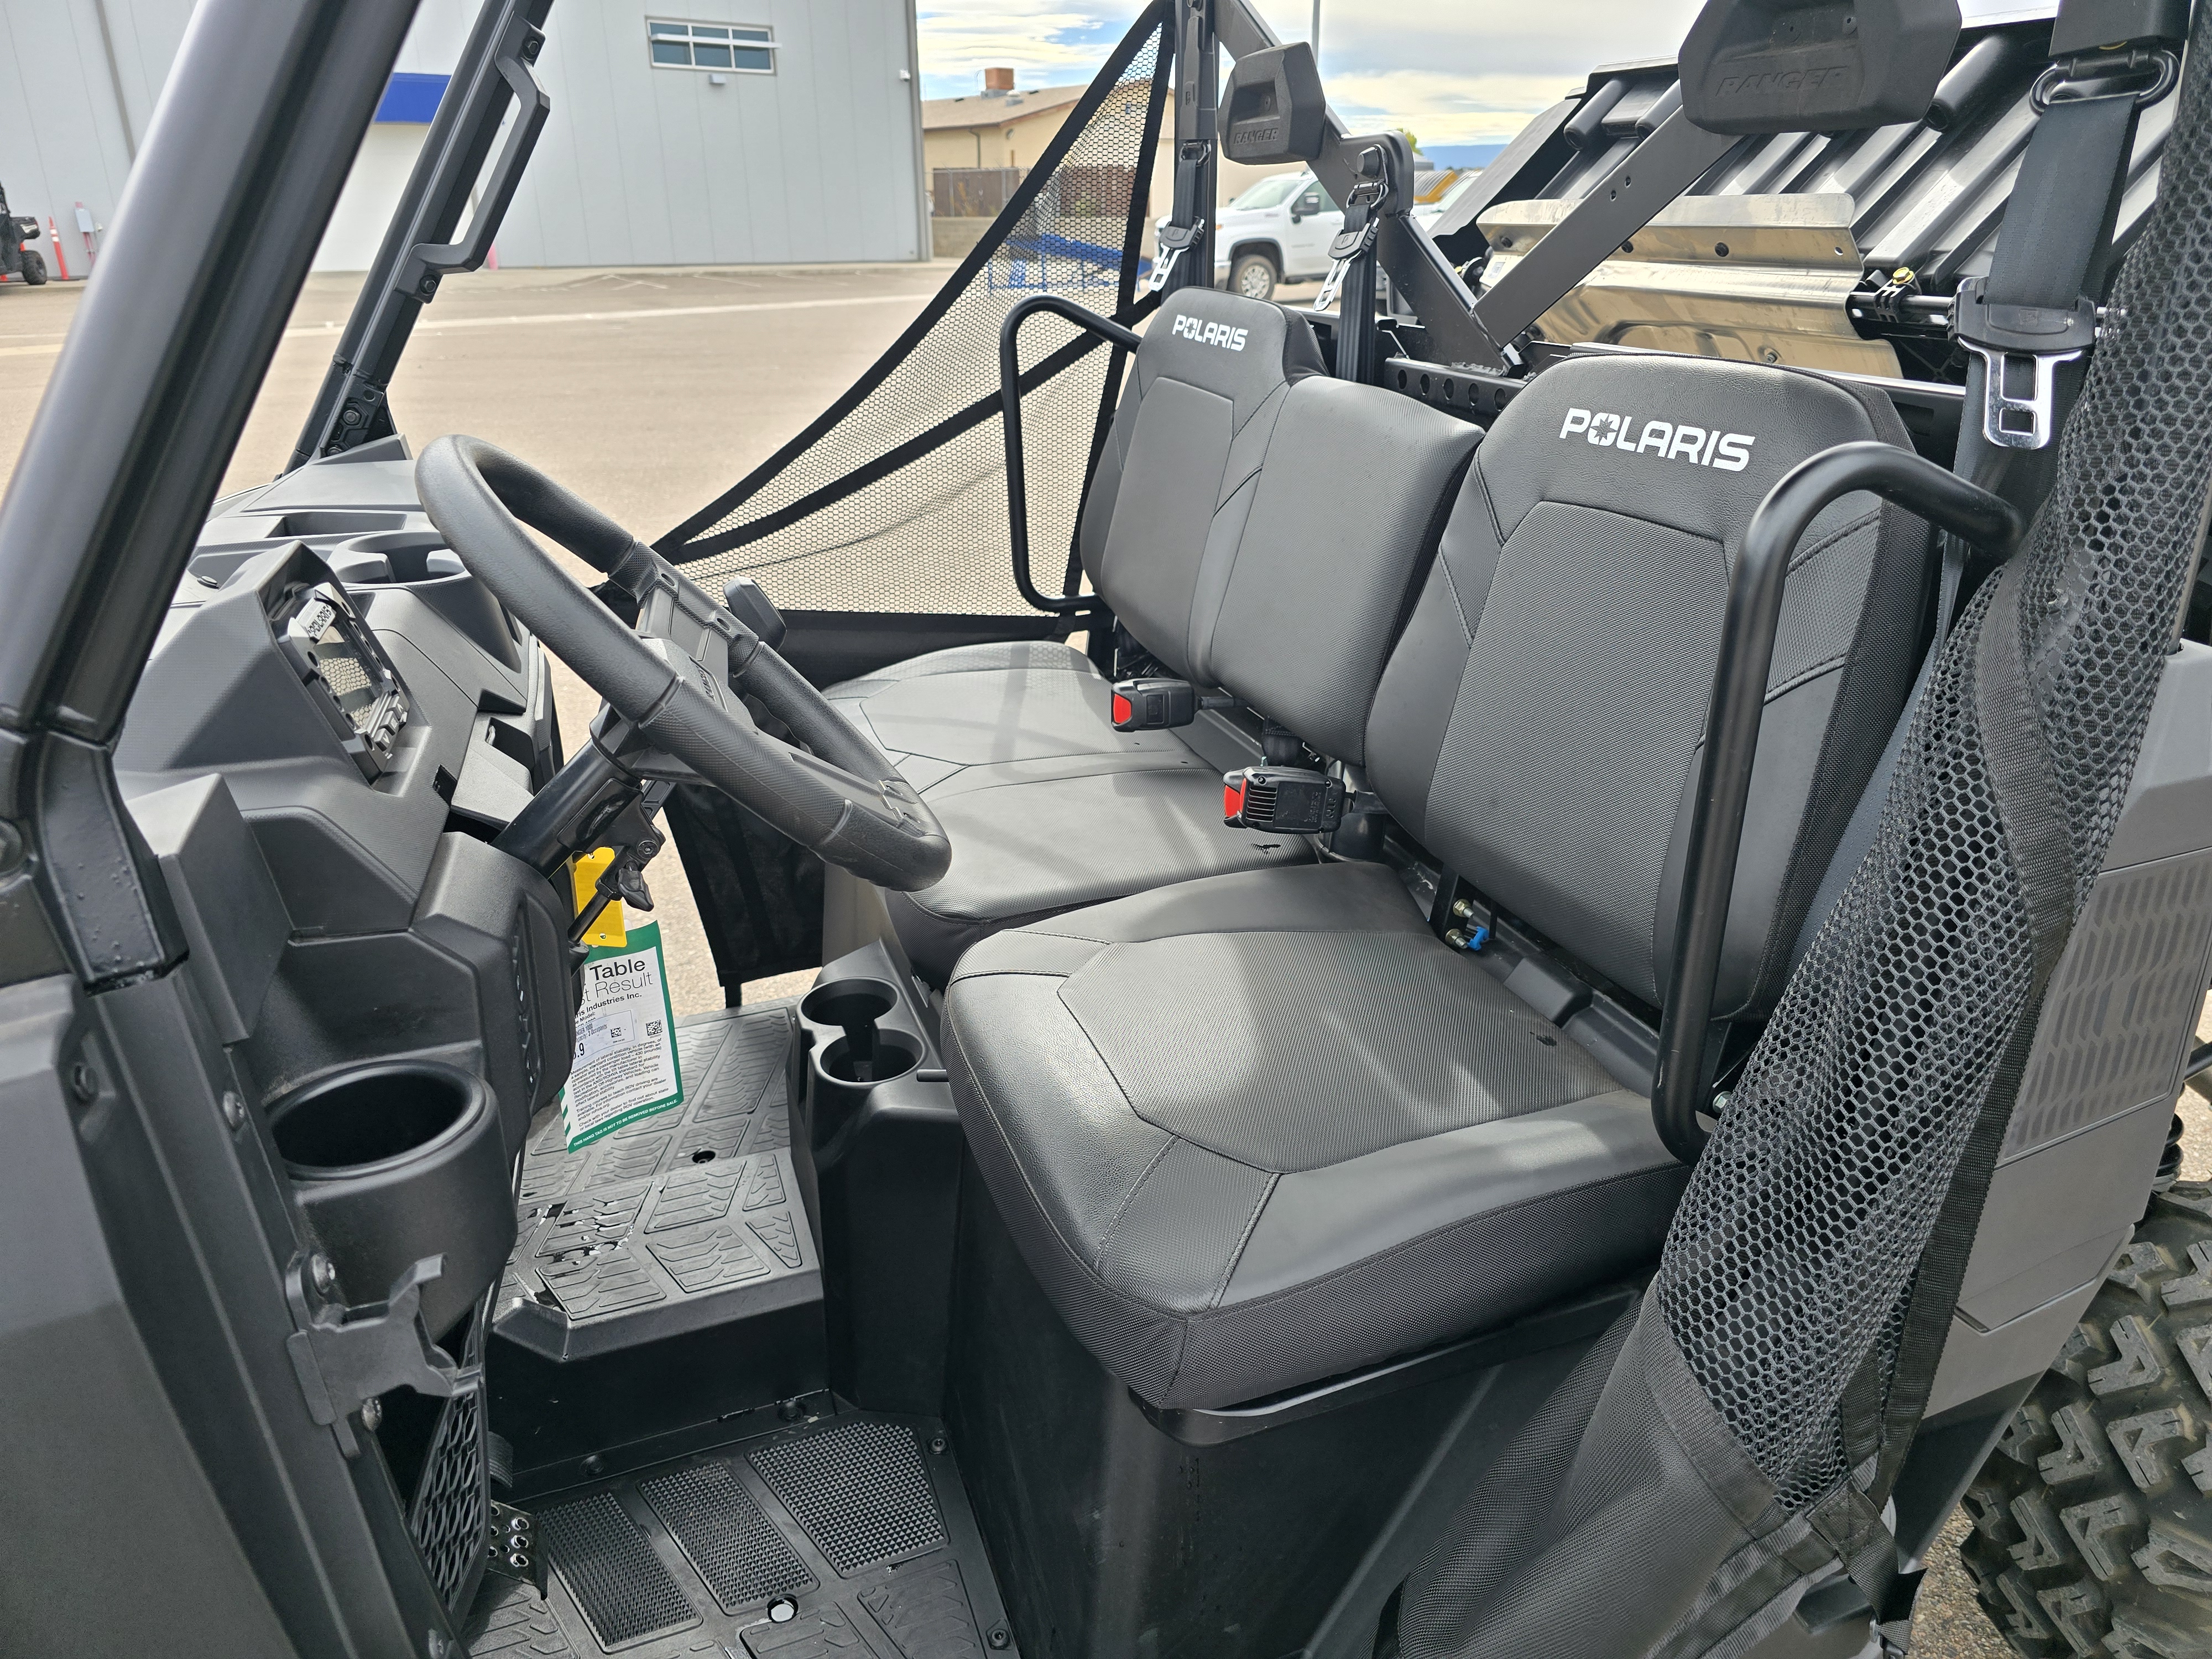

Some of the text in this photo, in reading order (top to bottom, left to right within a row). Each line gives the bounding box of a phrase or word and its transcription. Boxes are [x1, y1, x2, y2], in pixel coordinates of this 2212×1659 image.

[1715, 65, 1848, 96] RANGER
[1234, 128, 1279, 144] RANGER
[1172, 314, 1248, 352] POLARIS
[1559, 408, 1756, 472] POLARIS
[307, 606, 332, 637] POLARIS
[589, 959, 645, 980] Table
[595, 972, 653, 998] Result
[586, 996, 624, 1013] Industries
[580, 1011, 596, 1022] Model:
[591, 1024, 607, 1035] Occupants
[571, 1060, 595, 1075] Measurement
[572, 1073, 587, 1083] operator
[599, 1058, 620, 1070] passenger
[578, 1073, 596, 1084] measured
[609, 1057, 637, 1069] manufacturer
[589, 1059, 606, 1070] standard
[607, 1052, 627, 1061] condition
[573, 1078, 594, 1091] accordance
[575, 1084, 598, 1099] Recreational
[598, 1074, 623, 1087] Off-Highway
[600, 1078, 625, 1090] accessories,
[576, 1104, 592, 1113] Training
[592, 1096, 607, 1105] courses
[587, 1093, 599, 1101] lateral
[603, 1092, 625, 1104] information
[626, 1086, 642, 1094] contact
[578, 1113, 591, 1121] and/or
[579, 1119, 591, 1127] Check
[610, 1103, 622, 1112] dealer
[604, 1108, 623, 1119] regarding
[633, 1097, 655, 1105] operation.
[583, 1134, 594, 1143] HANG
[628, 1110, 649, 1120] REMOVED
[649, 1104, 666, 1112] BEFORE
